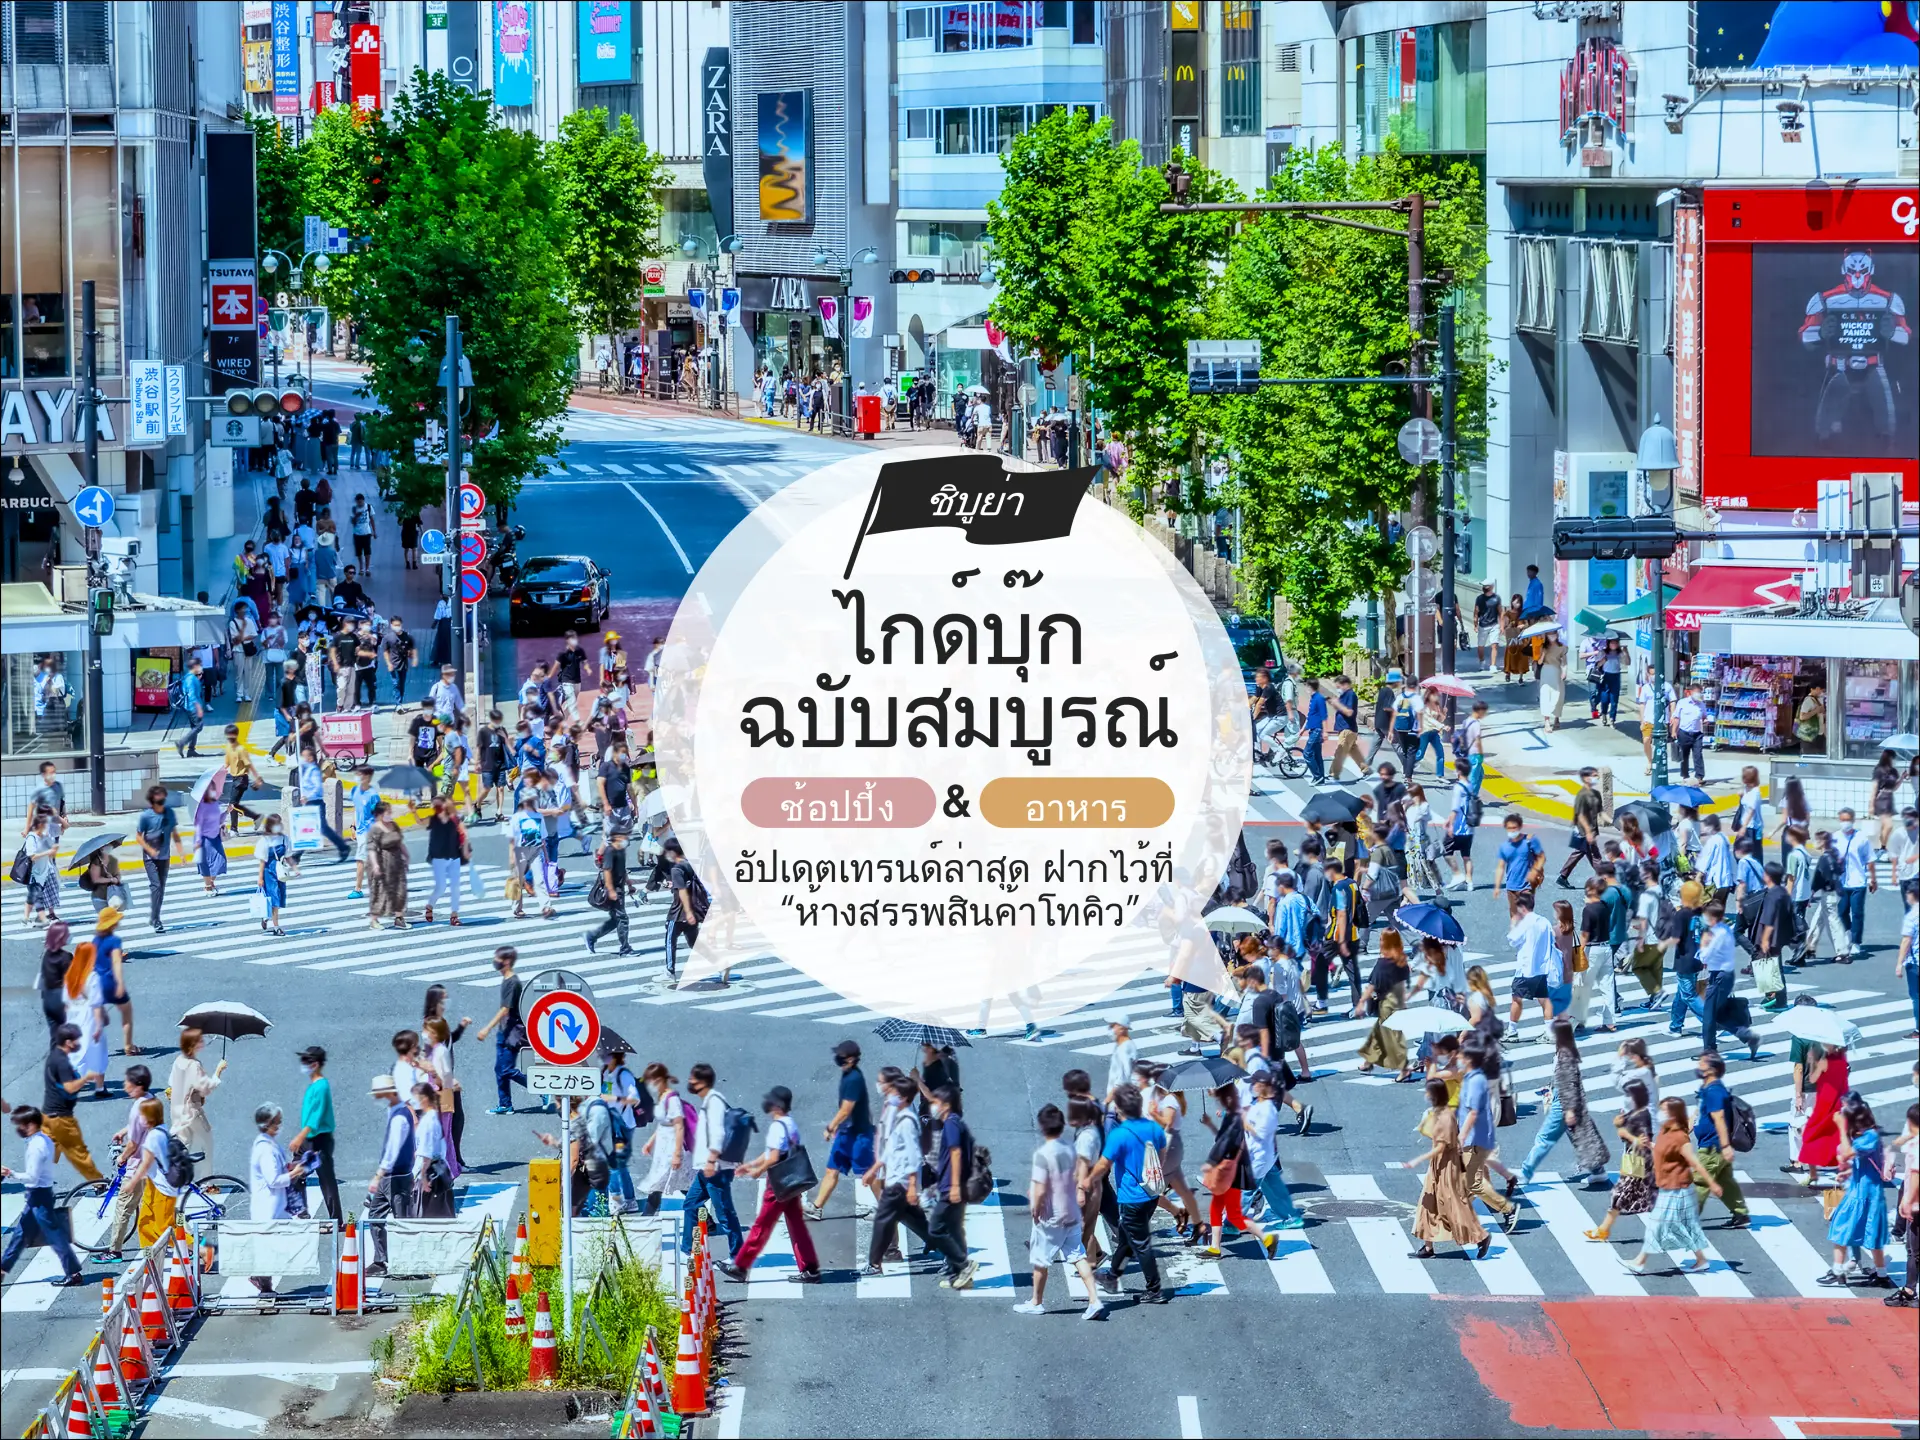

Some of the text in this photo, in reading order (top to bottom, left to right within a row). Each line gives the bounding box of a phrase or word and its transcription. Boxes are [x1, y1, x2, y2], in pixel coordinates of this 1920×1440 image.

[431, 17, 443, 27] 3F
[275, 3, 290, 68] 渋谷整形
[706, 66, 729, 156] ZARA
[210, 268, 254, 277] TSUTAYA
[277, 291, 289, 308] 8
[771, 276, 811, 310] ZARA
[217, 289, 248, 320] 本
[1840, 322, 1874, 330] WICKED
[228, 336, 240, 344] 7F
[217, 359, 251, 368] WIRED
[221, 368, 247, 376] TOKYO
[135, 377, 143, 408] Shibuya
[145, 367, 160, 434] 渋谷駅前
[169, 368, 182, 432] スクランブル式
[533, 1074, 595, 1090] ここから
